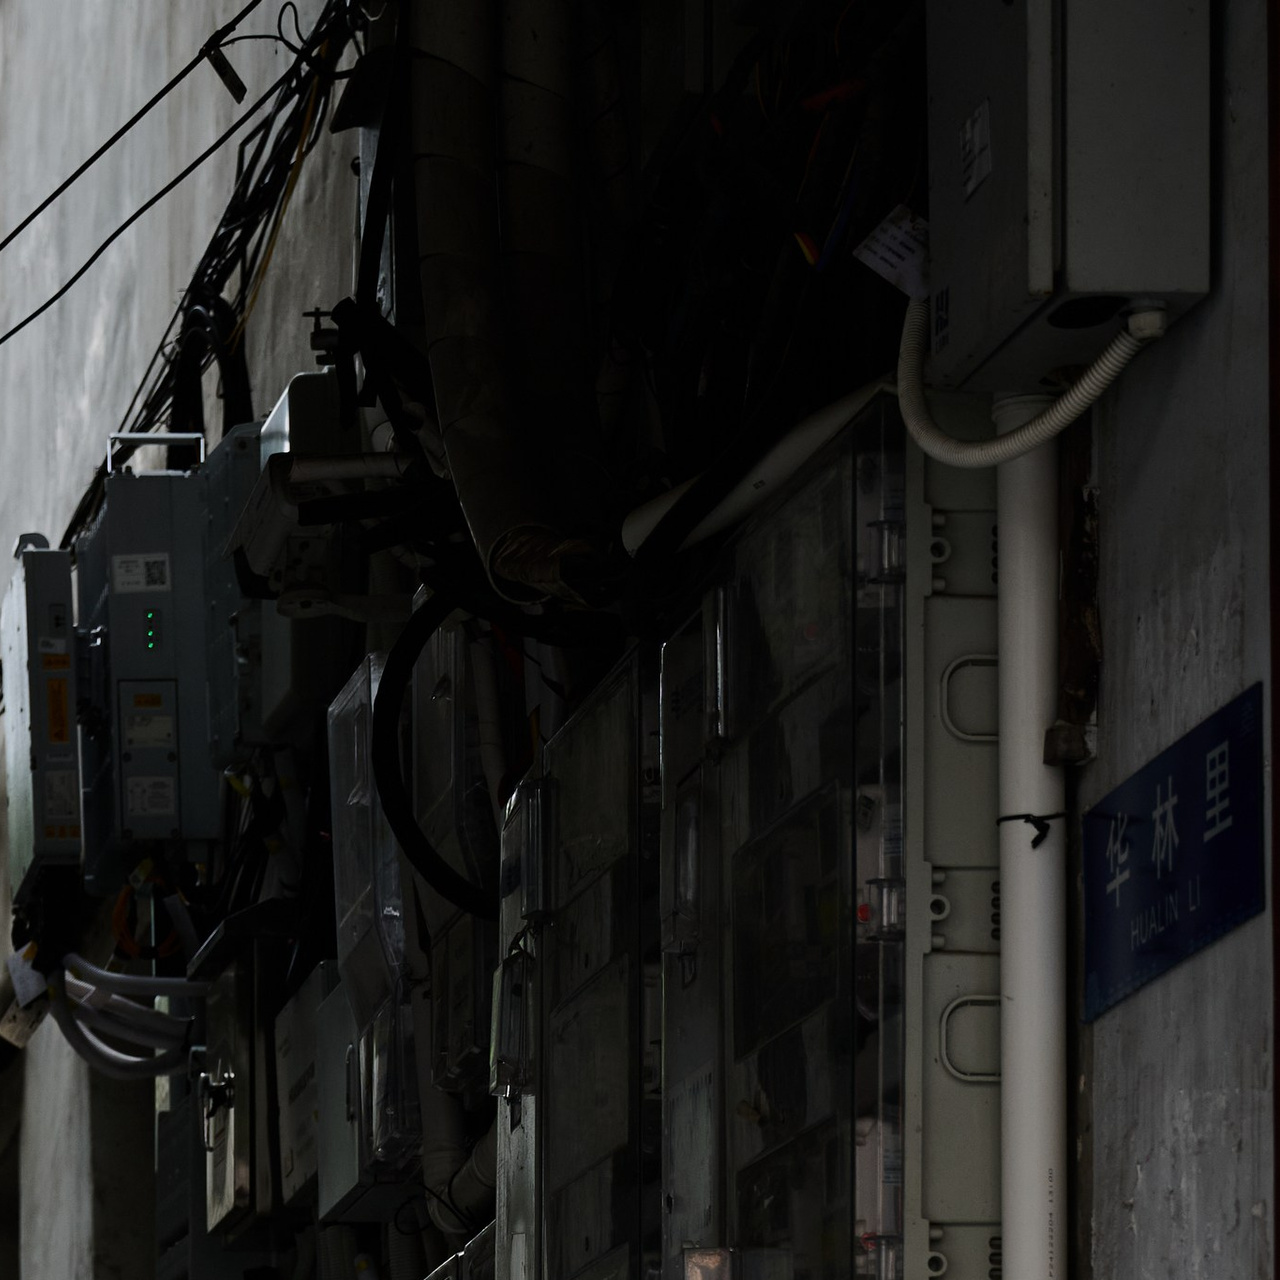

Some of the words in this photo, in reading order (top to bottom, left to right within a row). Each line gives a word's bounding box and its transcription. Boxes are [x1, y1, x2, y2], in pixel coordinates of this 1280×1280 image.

[1106, 738, 1234, 909] 华林里
[1130, 888, 1179, 951] HUALIN
[1188, 873, 1201, 912] LI
